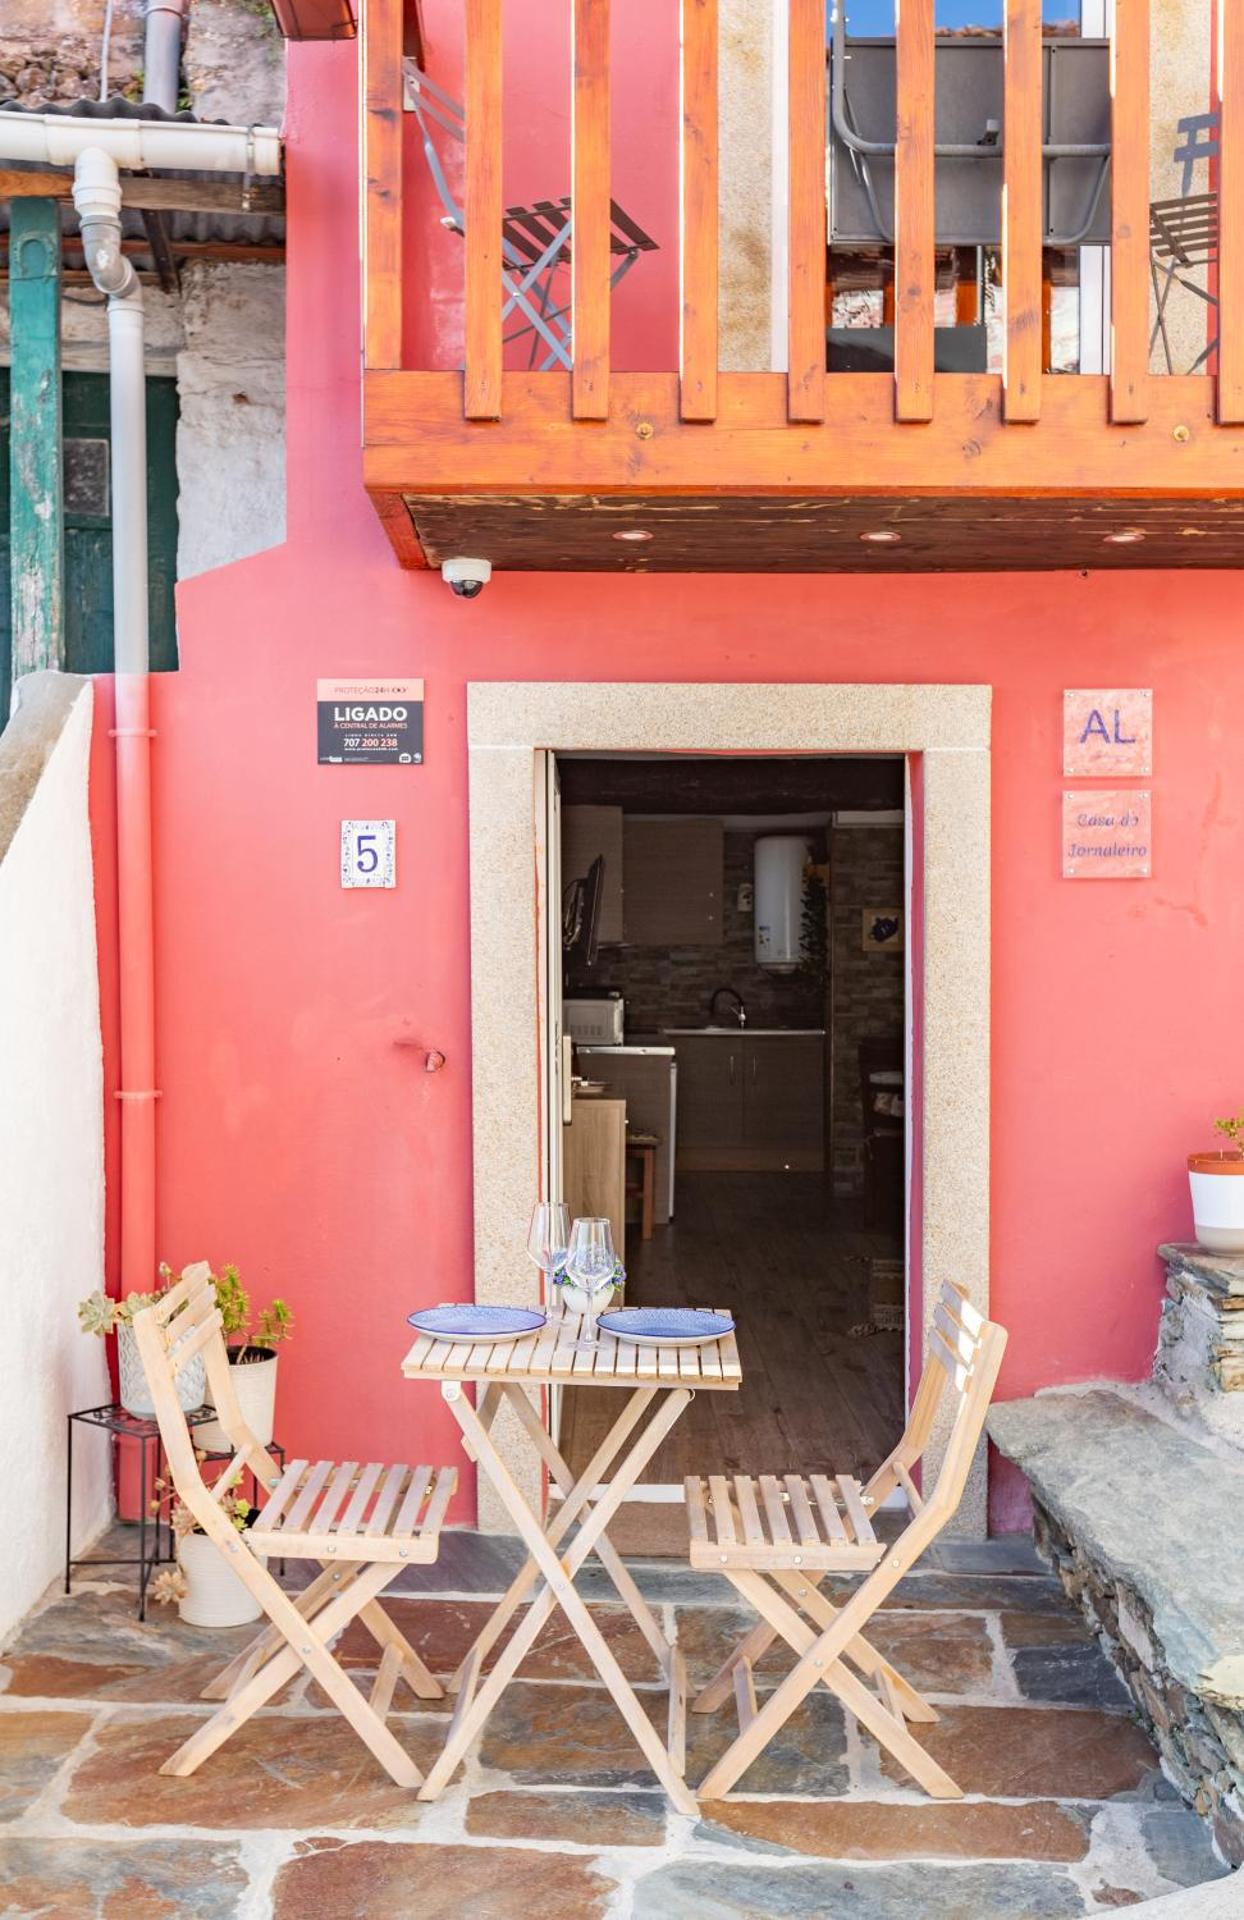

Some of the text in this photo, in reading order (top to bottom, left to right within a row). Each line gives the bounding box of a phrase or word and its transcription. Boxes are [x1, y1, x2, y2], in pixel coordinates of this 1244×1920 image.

[334, 707, 408, 721] LIGADO
[1080, 709, 1136, 743] AL
[344, 738, 398, 747] 707 200 238
[1077, 811, 1139, 827] Casa do
[357, 835, 378, 873] 5
[1068, 842, 1147, 858] Jornaleiro
